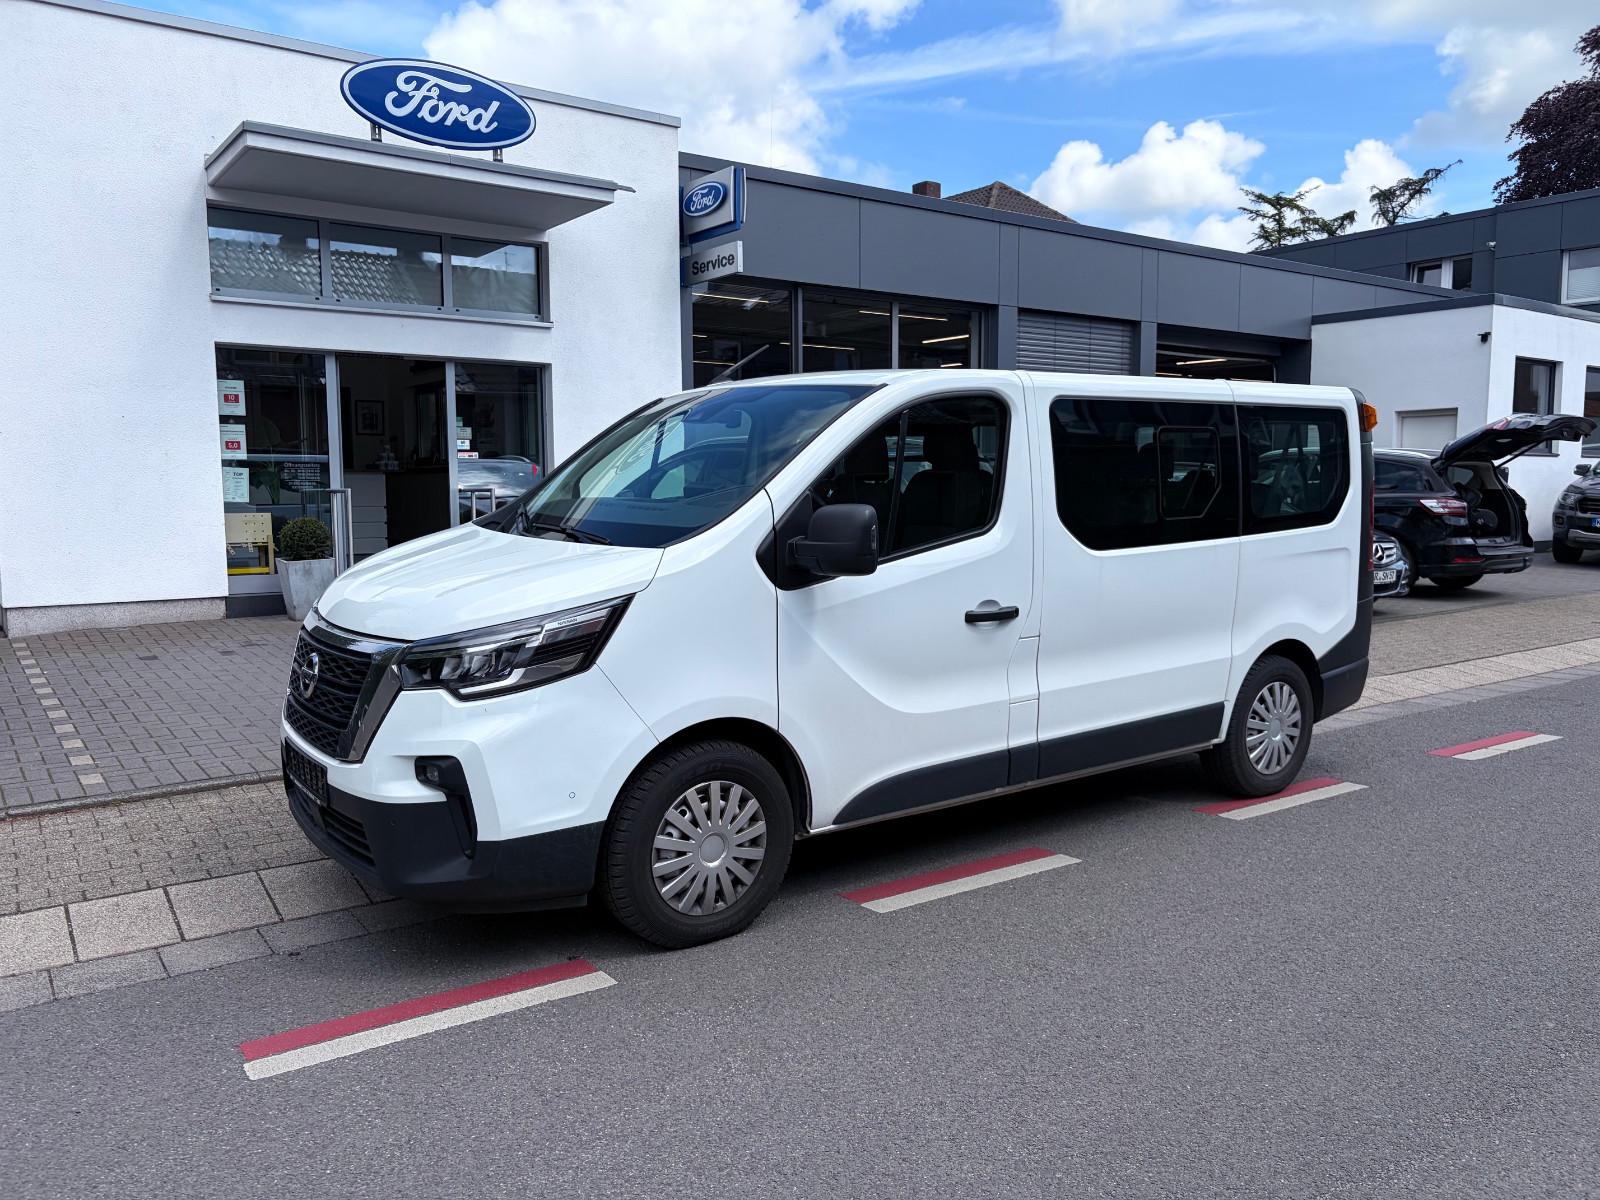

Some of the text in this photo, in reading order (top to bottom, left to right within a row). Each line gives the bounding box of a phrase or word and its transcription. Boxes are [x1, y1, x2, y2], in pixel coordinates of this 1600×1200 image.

[384, 70, 501, 134] Ford
[690, 187, 715, 212] Ford
[691, 253, 735, 276] Service
